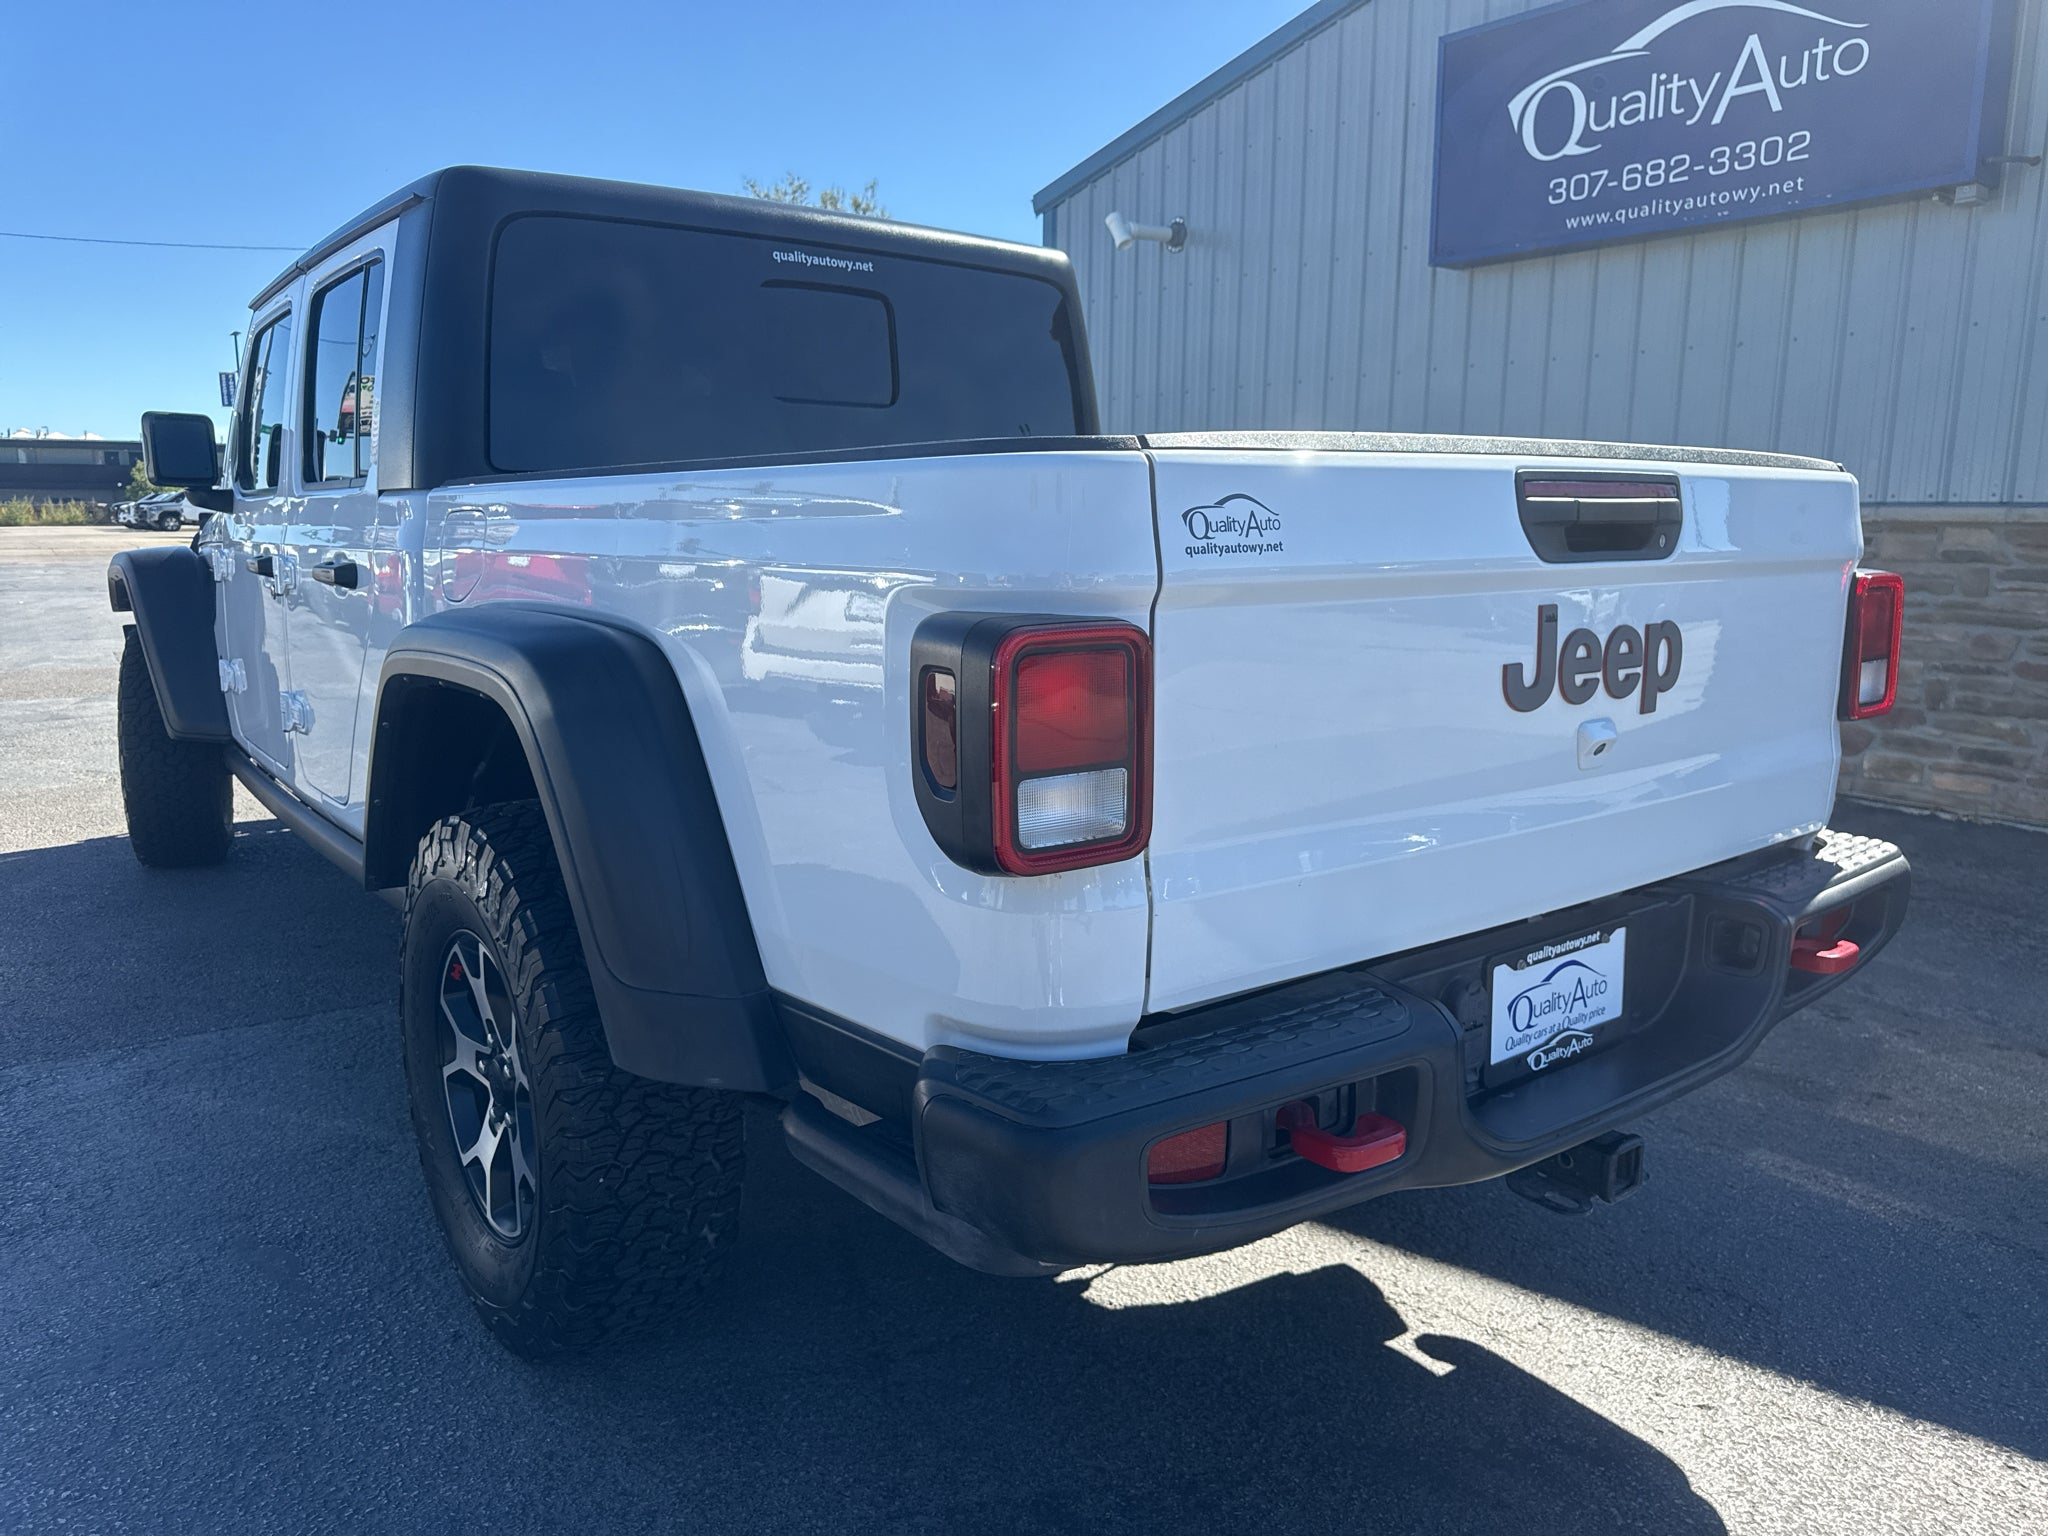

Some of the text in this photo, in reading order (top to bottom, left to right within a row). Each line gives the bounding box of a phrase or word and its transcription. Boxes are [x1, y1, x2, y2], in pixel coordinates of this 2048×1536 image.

[1548, 130, 1811, 205] 307-682-3302
[1565, 175, 1805, 230] www.qualityautowy.net
[772, 250, 874, 272] qualityautowy.net
[1185, 541, 1284, 558] qualityautowy.net
[1502, 603, 1683, 715] Jeep
[1526, 931, 1600, 964] qualityautowy.net
[1505, 1035, 1532, 1051] Quality
[1533, 1027, 1548, 1039] cars
[1549, 1023, 1556, 1034] at
[1562, 1012, 1588, 1030] Quality
[1588, 1006, 1606, 1024] price
